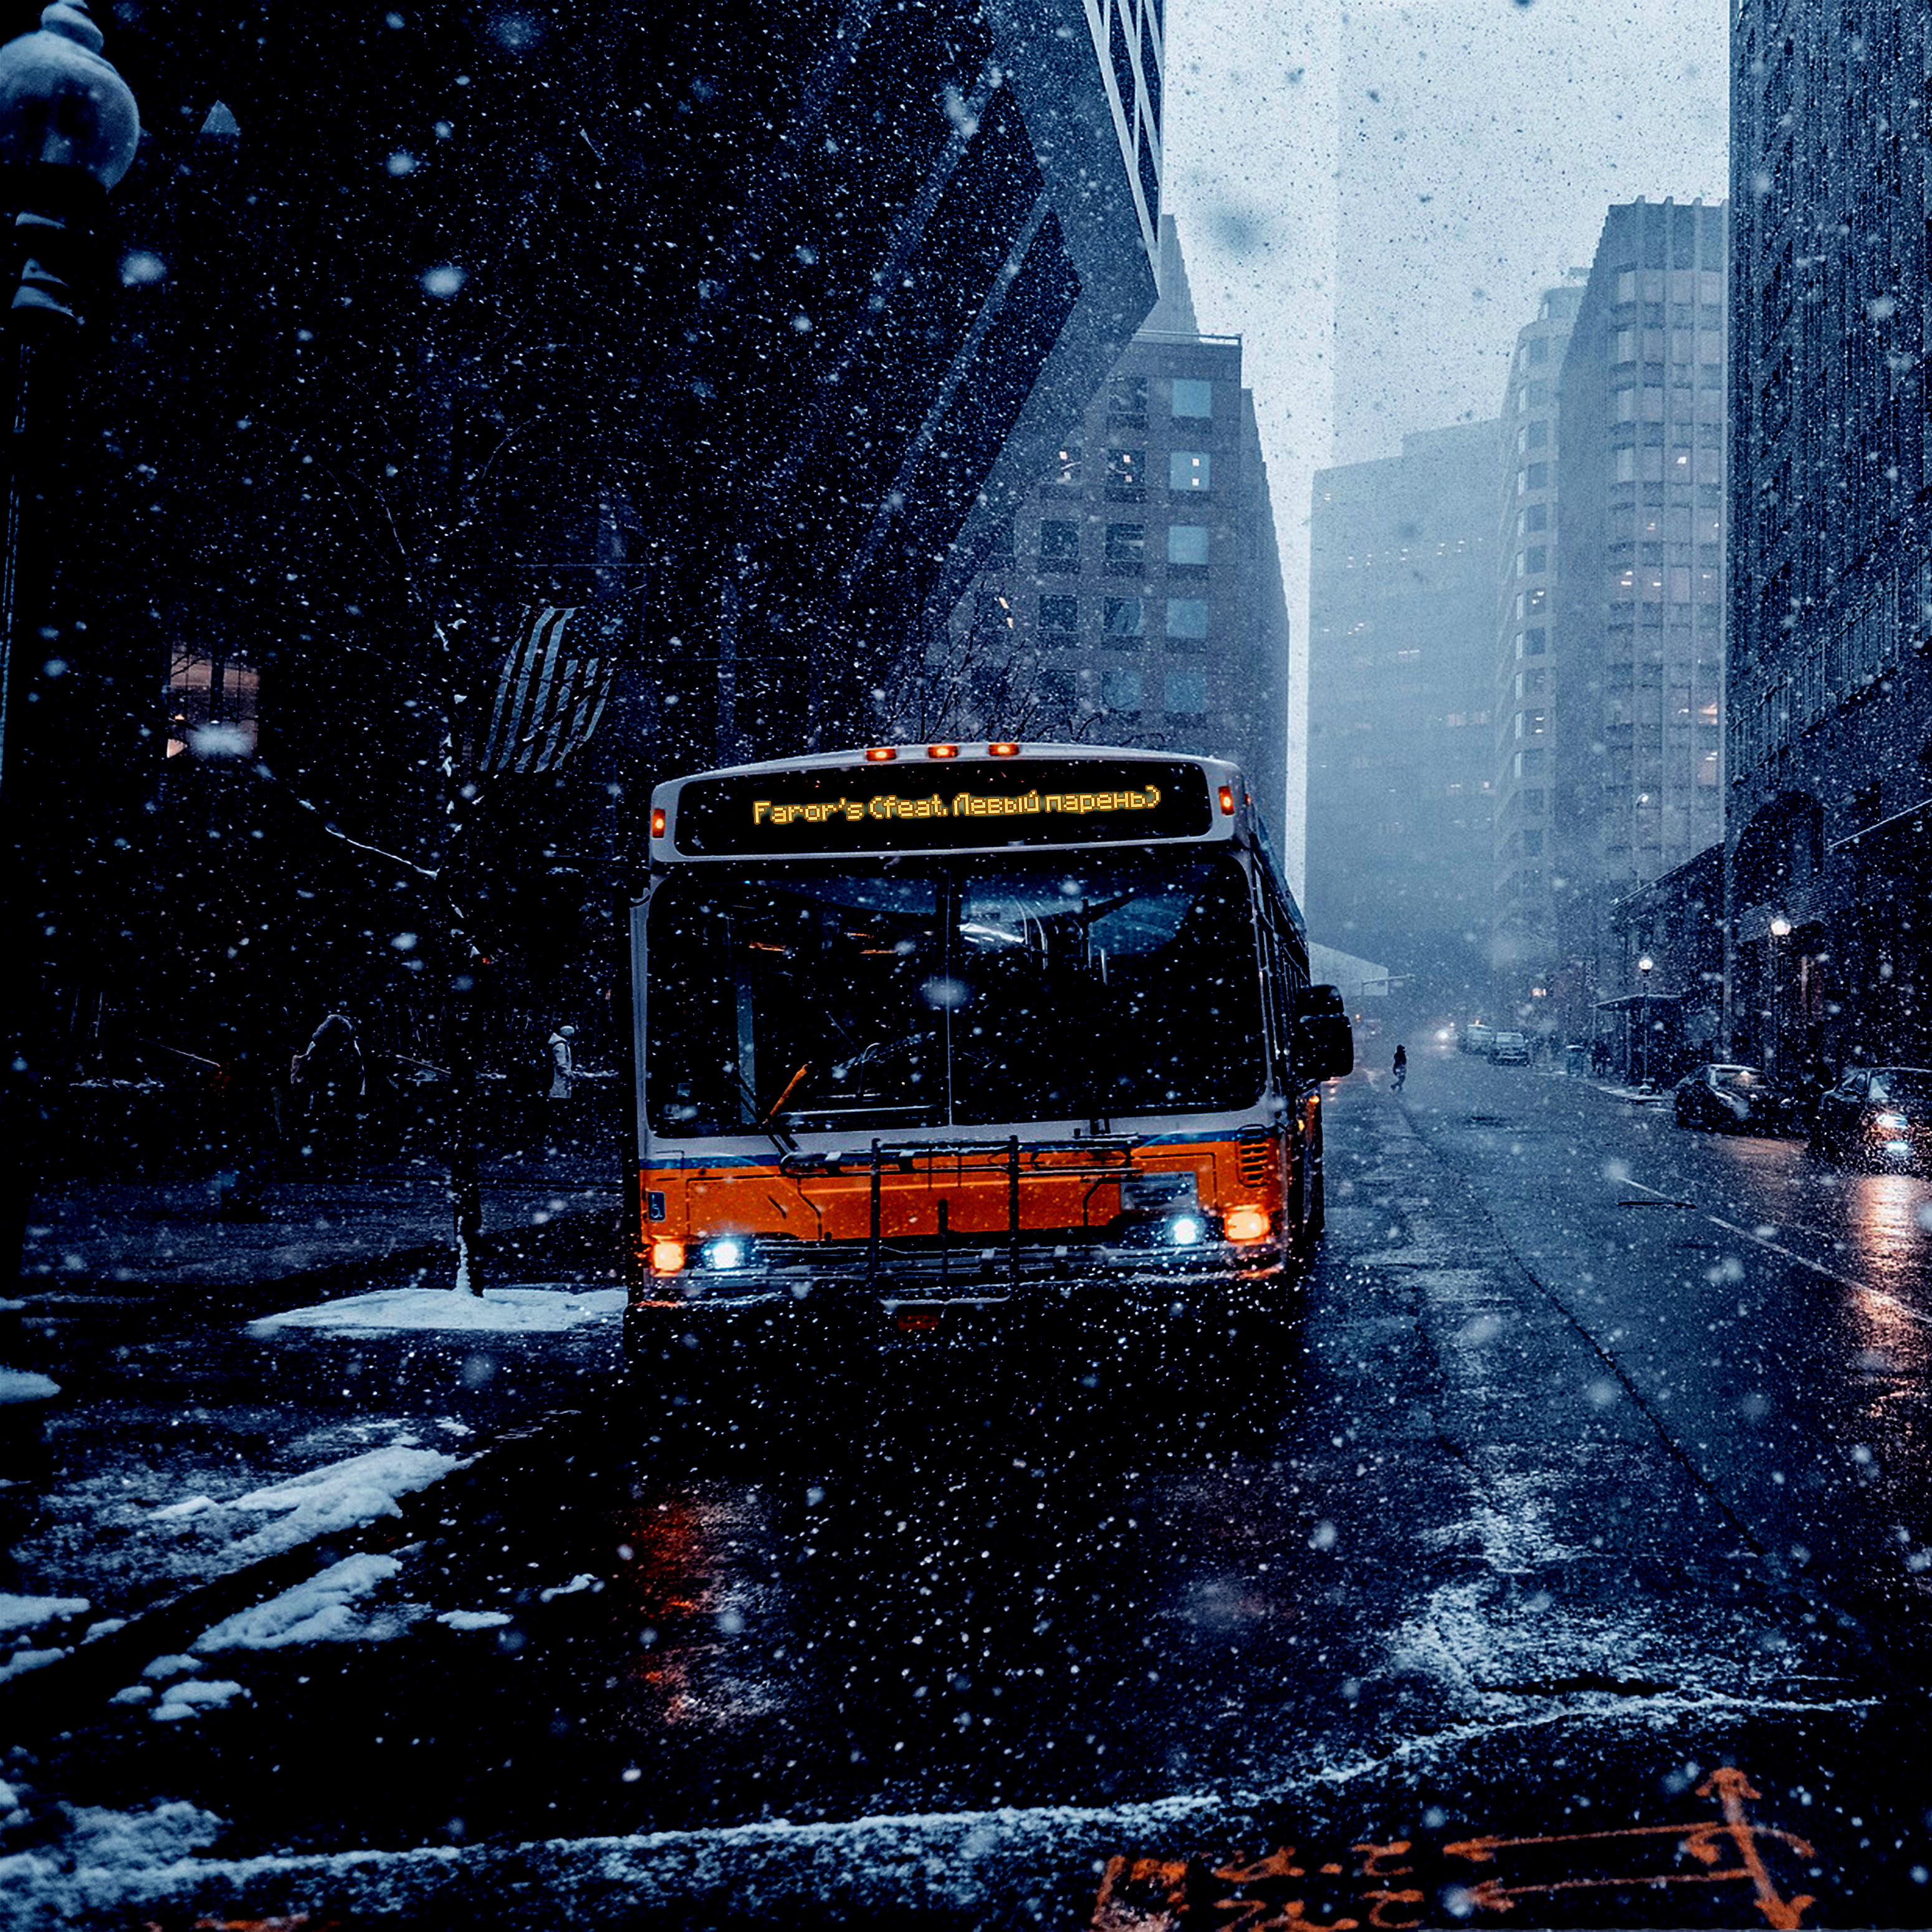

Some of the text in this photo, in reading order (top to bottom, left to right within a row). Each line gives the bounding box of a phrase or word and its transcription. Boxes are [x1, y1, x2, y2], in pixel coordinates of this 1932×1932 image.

[868, 794, 949, 819] (feat.
[952, 790, 1040, 816] Левый
[1045, 784, 1161, 815] парень)
